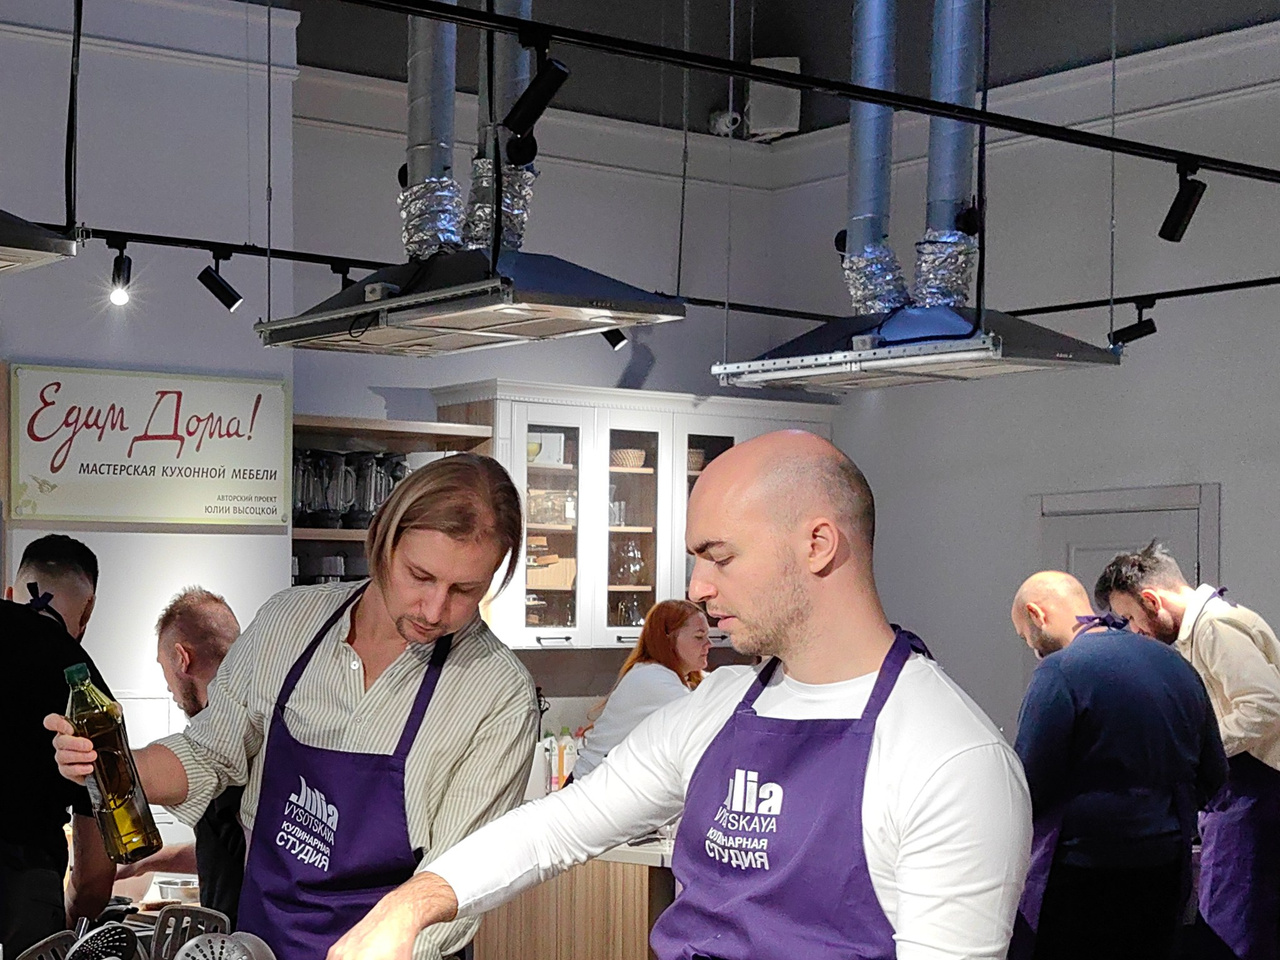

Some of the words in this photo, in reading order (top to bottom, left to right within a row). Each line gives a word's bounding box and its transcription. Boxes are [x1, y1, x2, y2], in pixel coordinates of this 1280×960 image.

[26, 381, 129, 474] Едим
[127, 390, 263, 459] Дома!
[78, 462, 156, 477] МАСТЕРСКАЯ
[161, 465, 226, 480] КУХОННОЙ
[231, 468, 278, 481] МЕБЕЛИ
[204, 505, 231, 514] ЮЛИИ
[232, 505, 278, 516] ВЫСОЦКОЙ
[217, 494, 253, 502] АВТОРСКИЙ
[254, 495, 277, 503] ПРОЕКТ
[288, 775, 339, 832] Julia
[281, 820, 331, 857] КУЛИНАРНАЯ
[283, 802, 335, 846] VYSOTSKAYA
[275, 831, 330, 872] СТУДИЯ
[705, 839, 770, 871] СТУДИЯ
